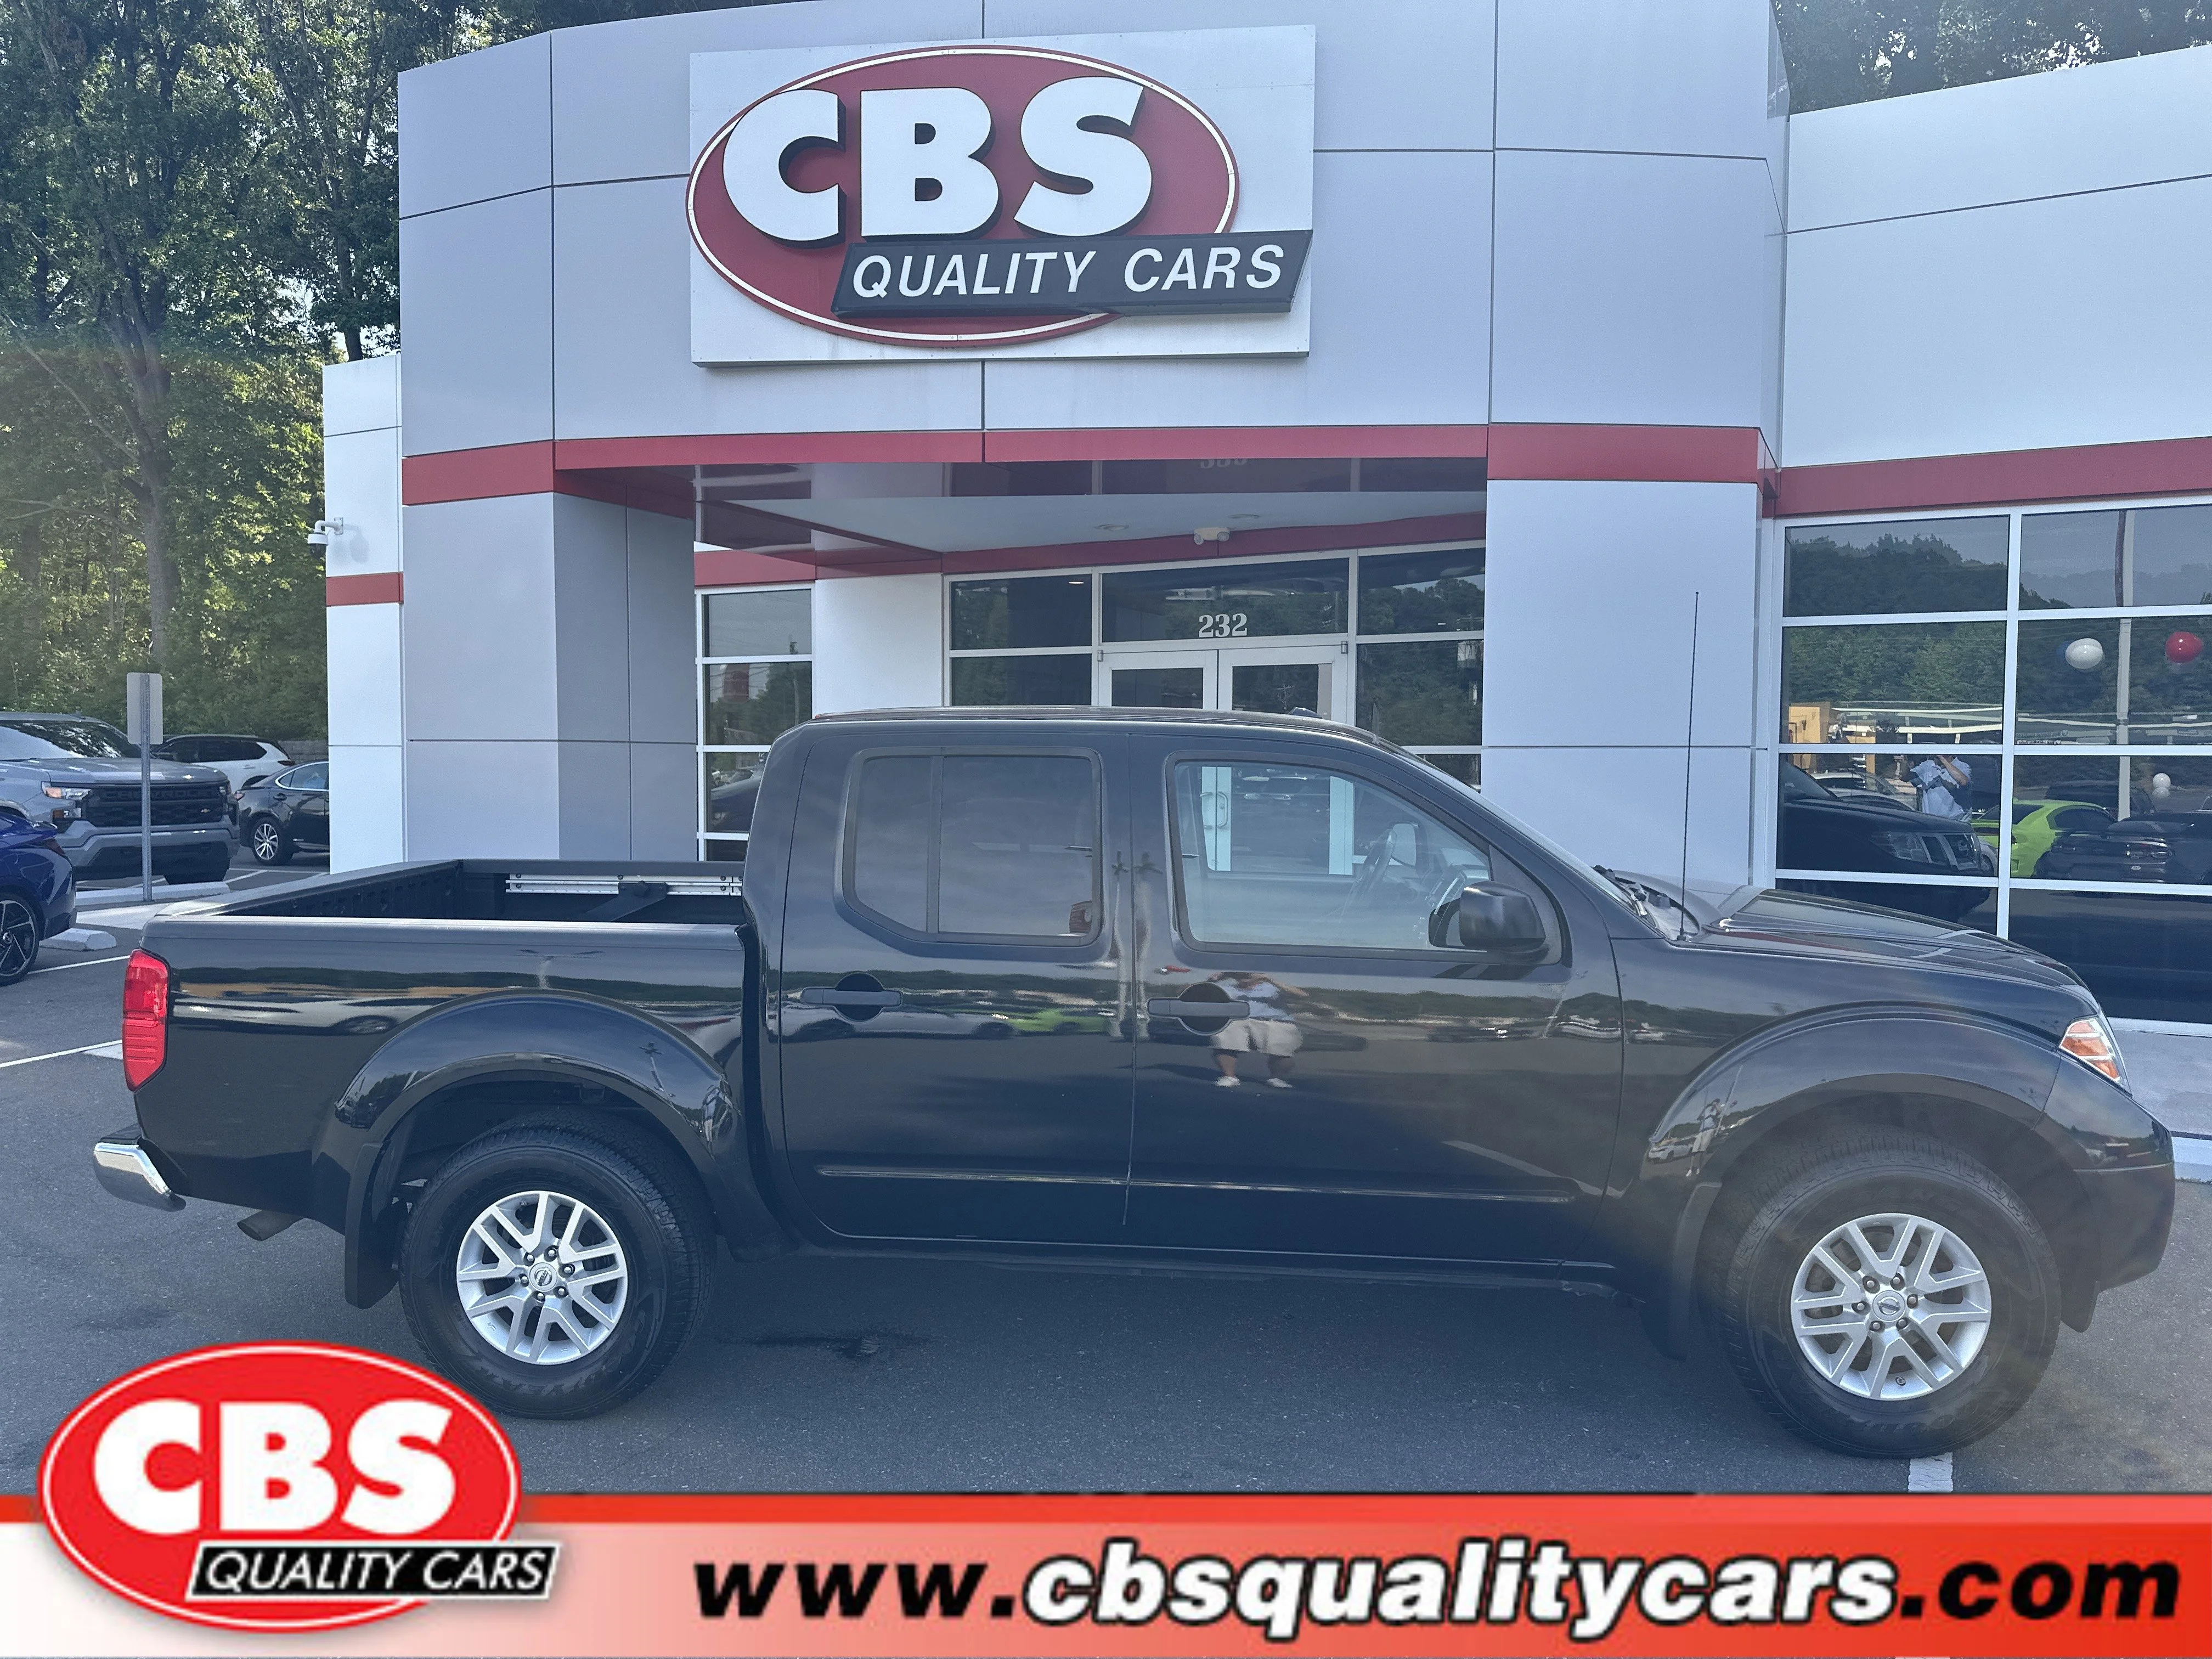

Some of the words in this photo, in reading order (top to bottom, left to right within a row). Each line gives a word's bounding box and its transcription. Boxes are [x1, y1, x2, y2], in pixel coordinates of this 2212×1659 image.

[722, 75, 1154, 242] CBS
[852, 250, 1097, 300] QUALITY
[1124, 244, 1285, 292] CARS
[1198, 613, 1248, 637] 232
